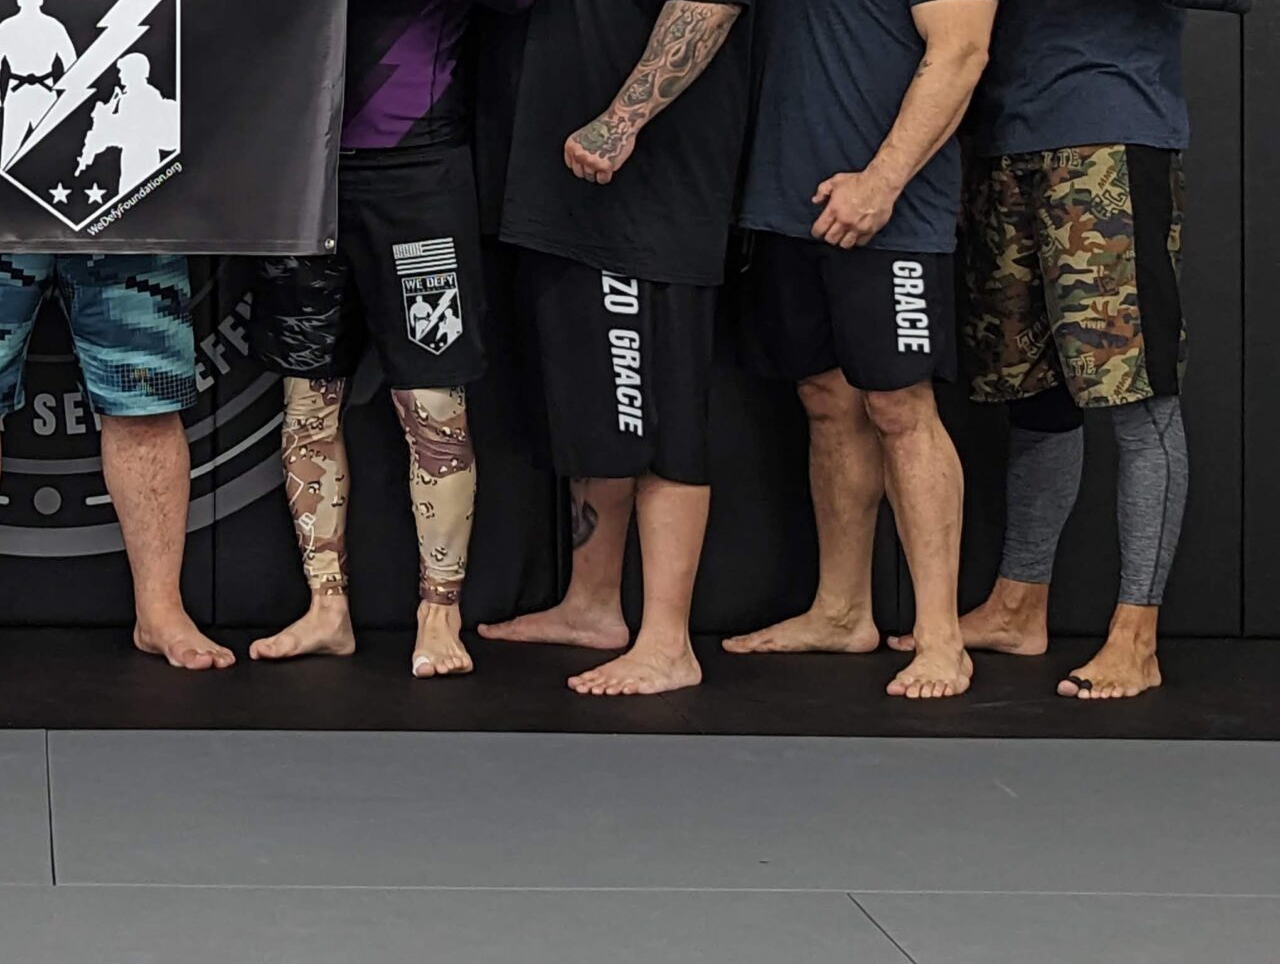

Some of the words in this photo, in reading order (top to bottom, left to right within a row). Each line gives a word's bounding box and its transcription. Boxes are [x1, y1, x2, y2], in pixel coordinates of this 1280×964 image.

[86, 161, 183, 236] WeDefyFoundation.org
[892, 259, 931, 354] GRACIE
[608, 328, 644, 437] GRACIE
